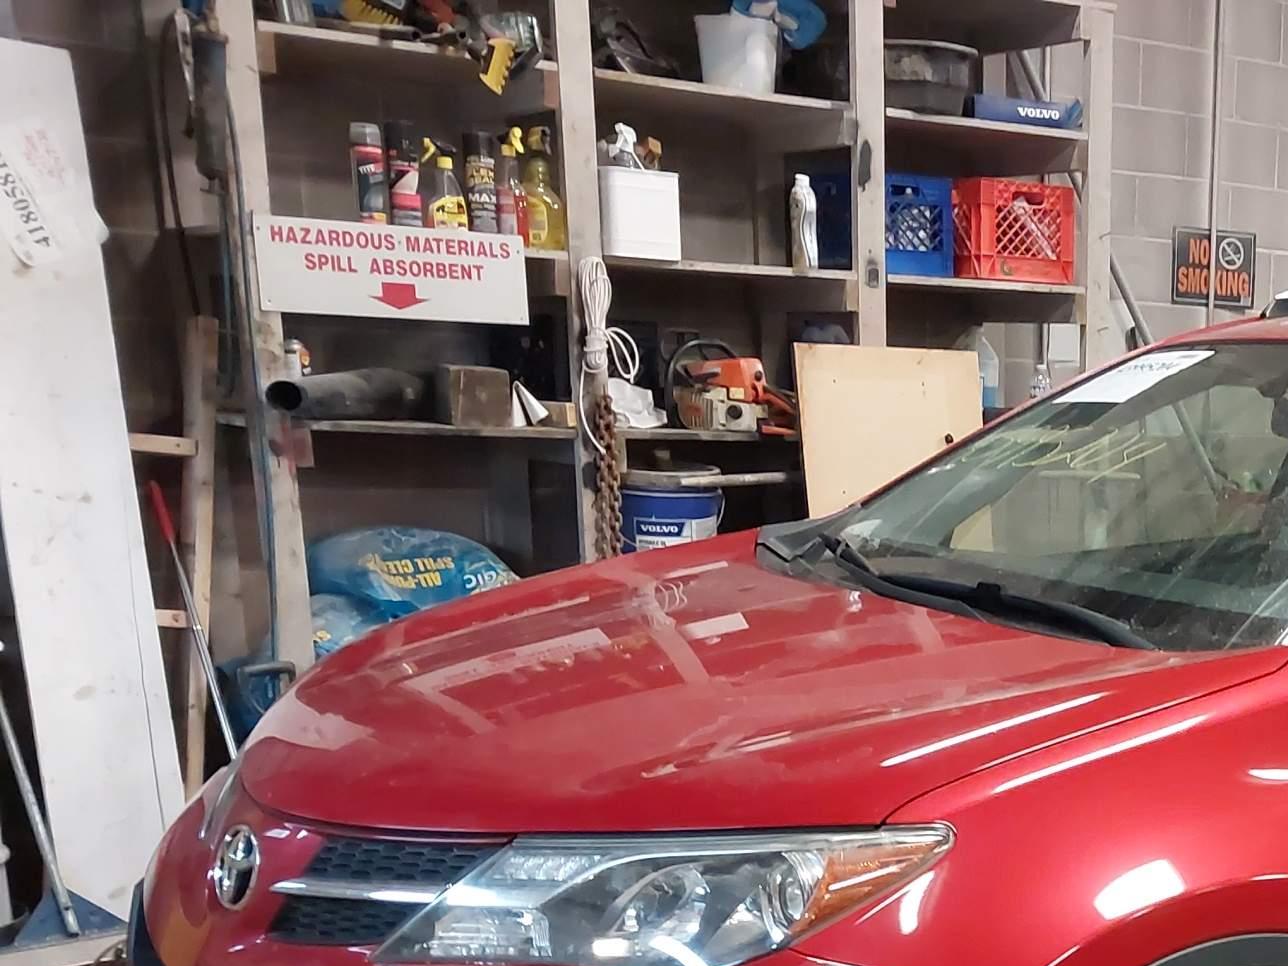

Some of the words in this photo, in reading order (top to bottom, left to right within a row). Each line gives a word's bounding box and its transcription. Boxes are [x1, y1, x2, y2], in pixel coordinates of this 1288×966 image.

[1017, 106, 1060, 120] VOLVO
[468, 192, 497, 204] MAX
[270, 225, 396, 251] HAZARDOUS
[405, 235, 512, 260] MATERIALS
[1188, 237, 1210, 266] NO
[304, 252, 358, 273] SPILL
[369, 257, 485, 281] ABSORBENT
[1177, 266, 1250, 298] SMOKING
[639, 523, 679, 534] VOLVO
[416, 556, 455, 573] SPILL
